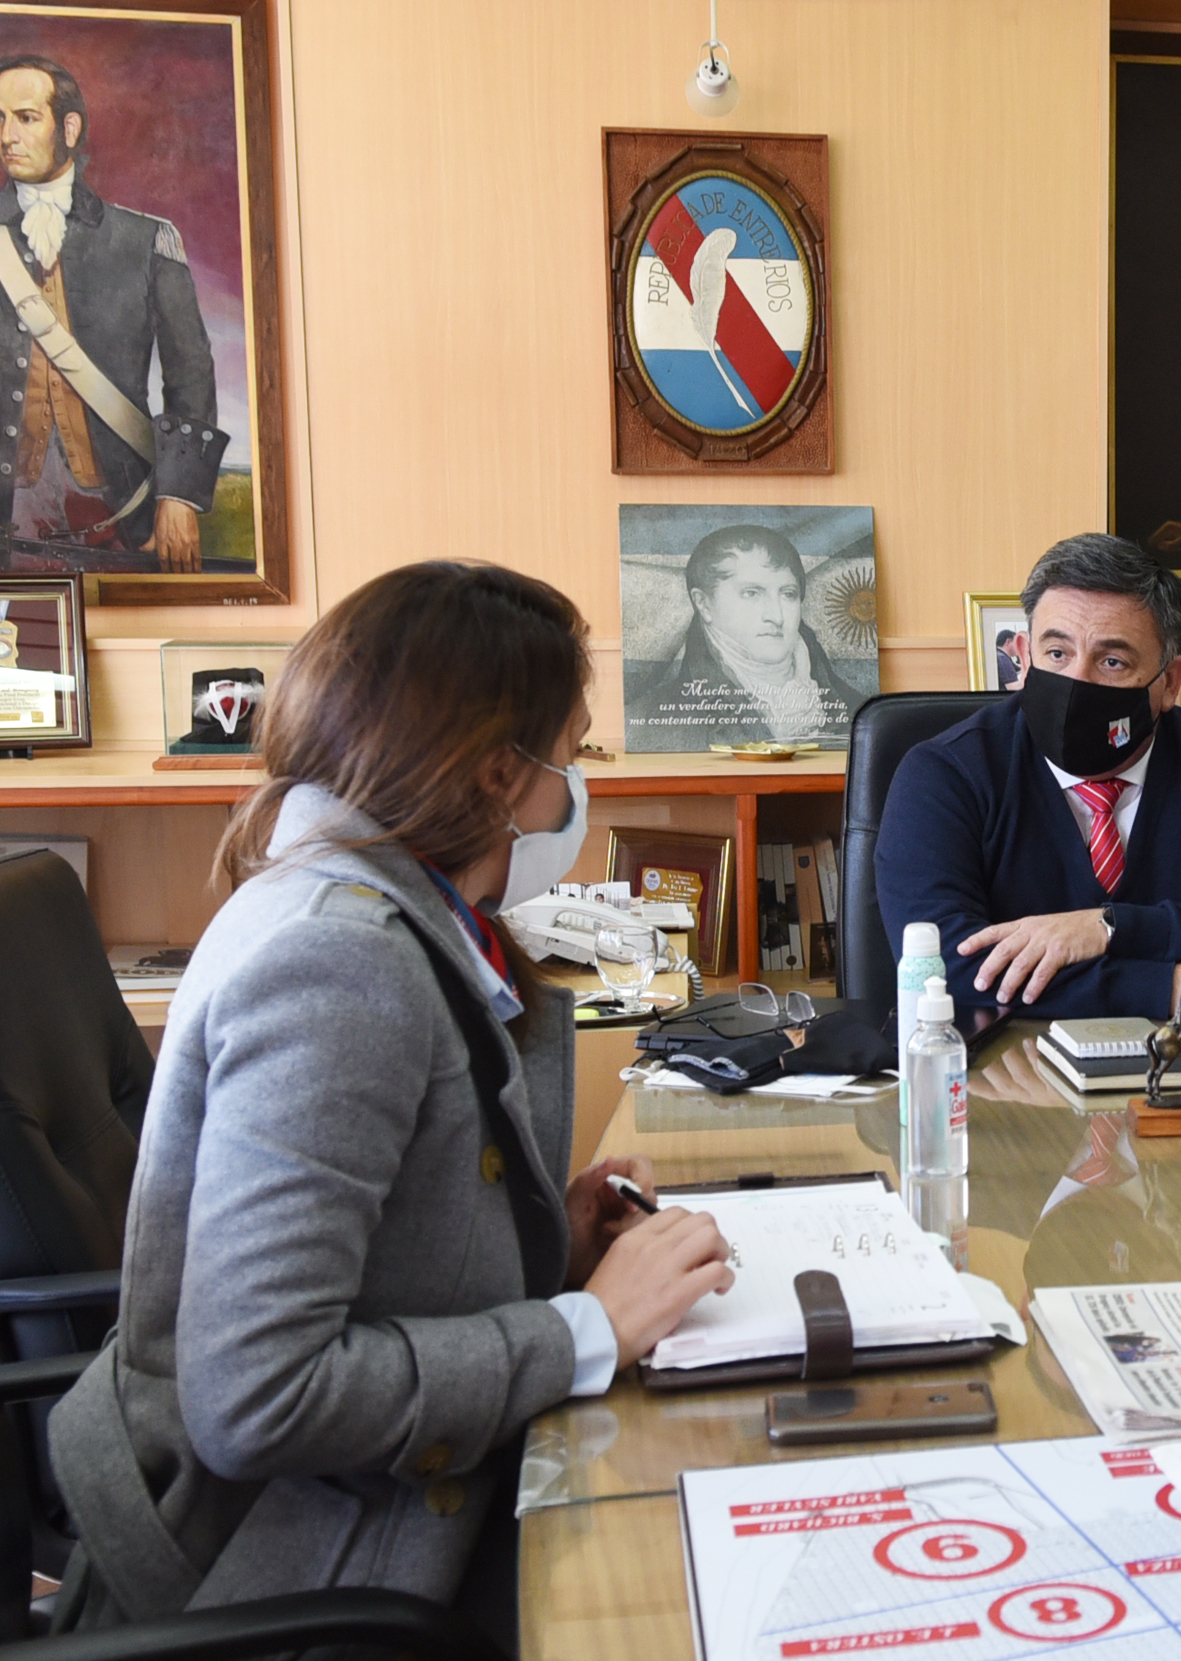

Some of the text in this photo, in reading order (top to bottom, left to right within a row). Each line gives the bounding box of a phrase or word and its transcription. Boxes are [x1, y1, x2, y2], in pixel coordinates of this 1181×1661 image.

[701, 191, 728, 214] DE
[728, 200, 781, 264] ENTRE
[763, 264, 793, 314] RIOS
[681, 679, 731, 696] Mucho
[659, 702, 676, 711] un
[678, 698, 736, 711] verdadero
[629, 717, 646, 725] me
[718, 716, 738, 725] con
[740, 716, 758, 725] ser
[835, 713, 849, 724] de
[1029, 1597, 1082, 1624] 8
